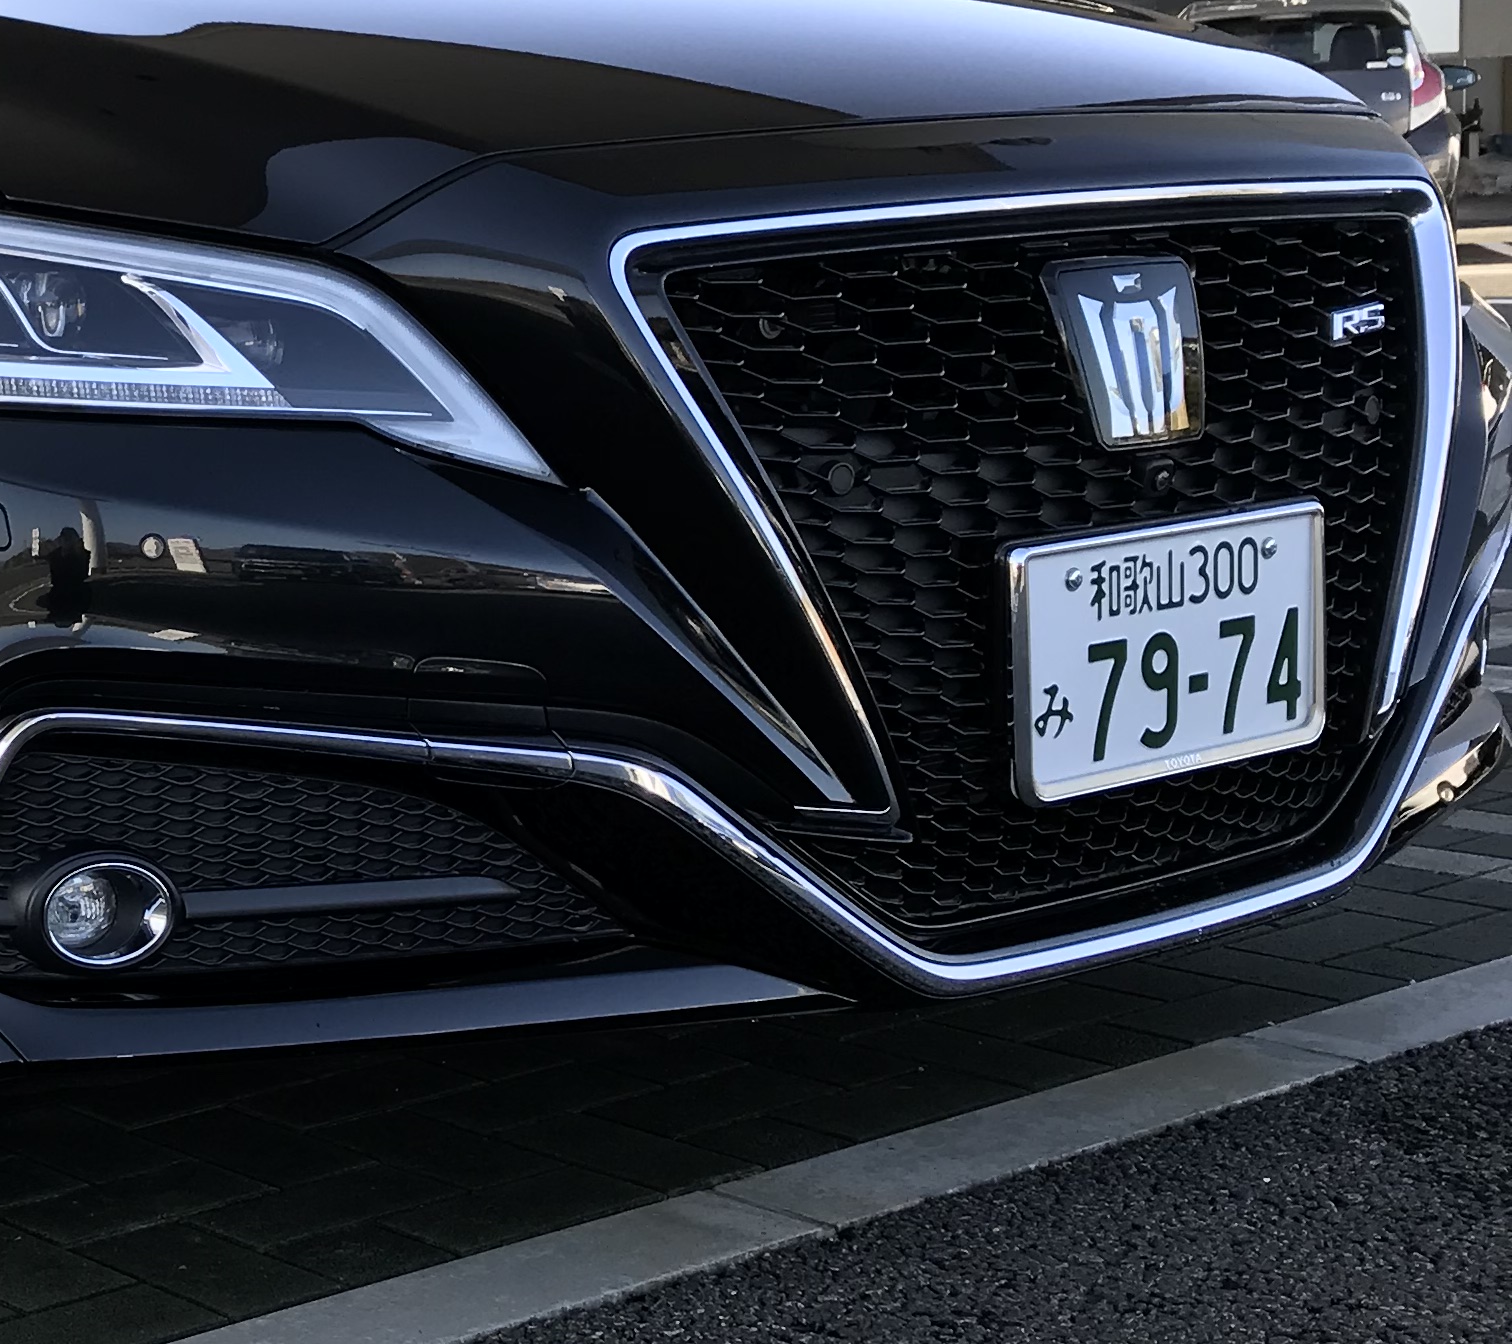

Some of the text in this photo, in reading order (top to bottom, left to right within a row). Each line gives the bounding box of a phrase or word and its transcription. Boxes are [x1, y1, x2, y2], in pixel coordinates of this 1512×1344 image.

[1332, 303, 1385, 341] RS
[1033, 606, 1302, 762] み 79-74
[1164, 753, 1202, 771] TOYOTA
